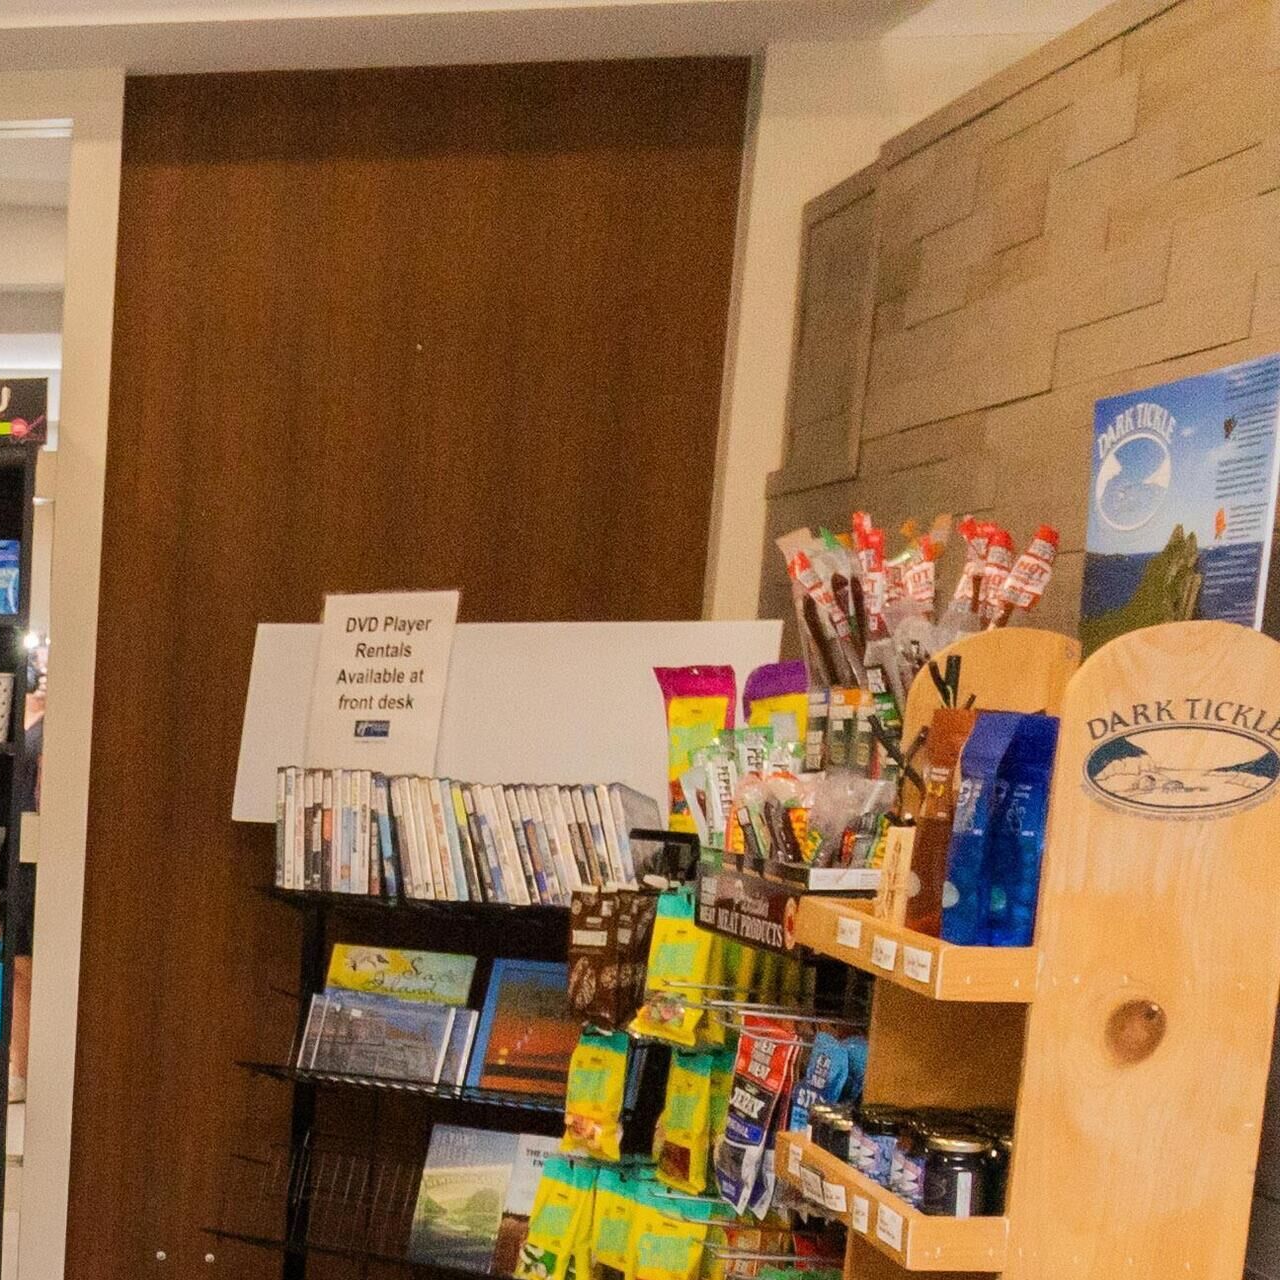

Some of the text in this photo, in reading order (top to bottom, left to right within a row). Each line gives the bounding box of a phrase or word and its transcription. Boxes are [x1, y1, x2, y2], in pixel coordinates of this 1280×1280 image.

[1097, 407, 1134, 459] DARK
[345, 616, 432, 635] DVD Player
[355, 642, 412, 658] Rentals
[336, 668, 424, 684] Available at
[338, 693, 414, 710] front desk
[1087, 700, 1176, 741] DARK
